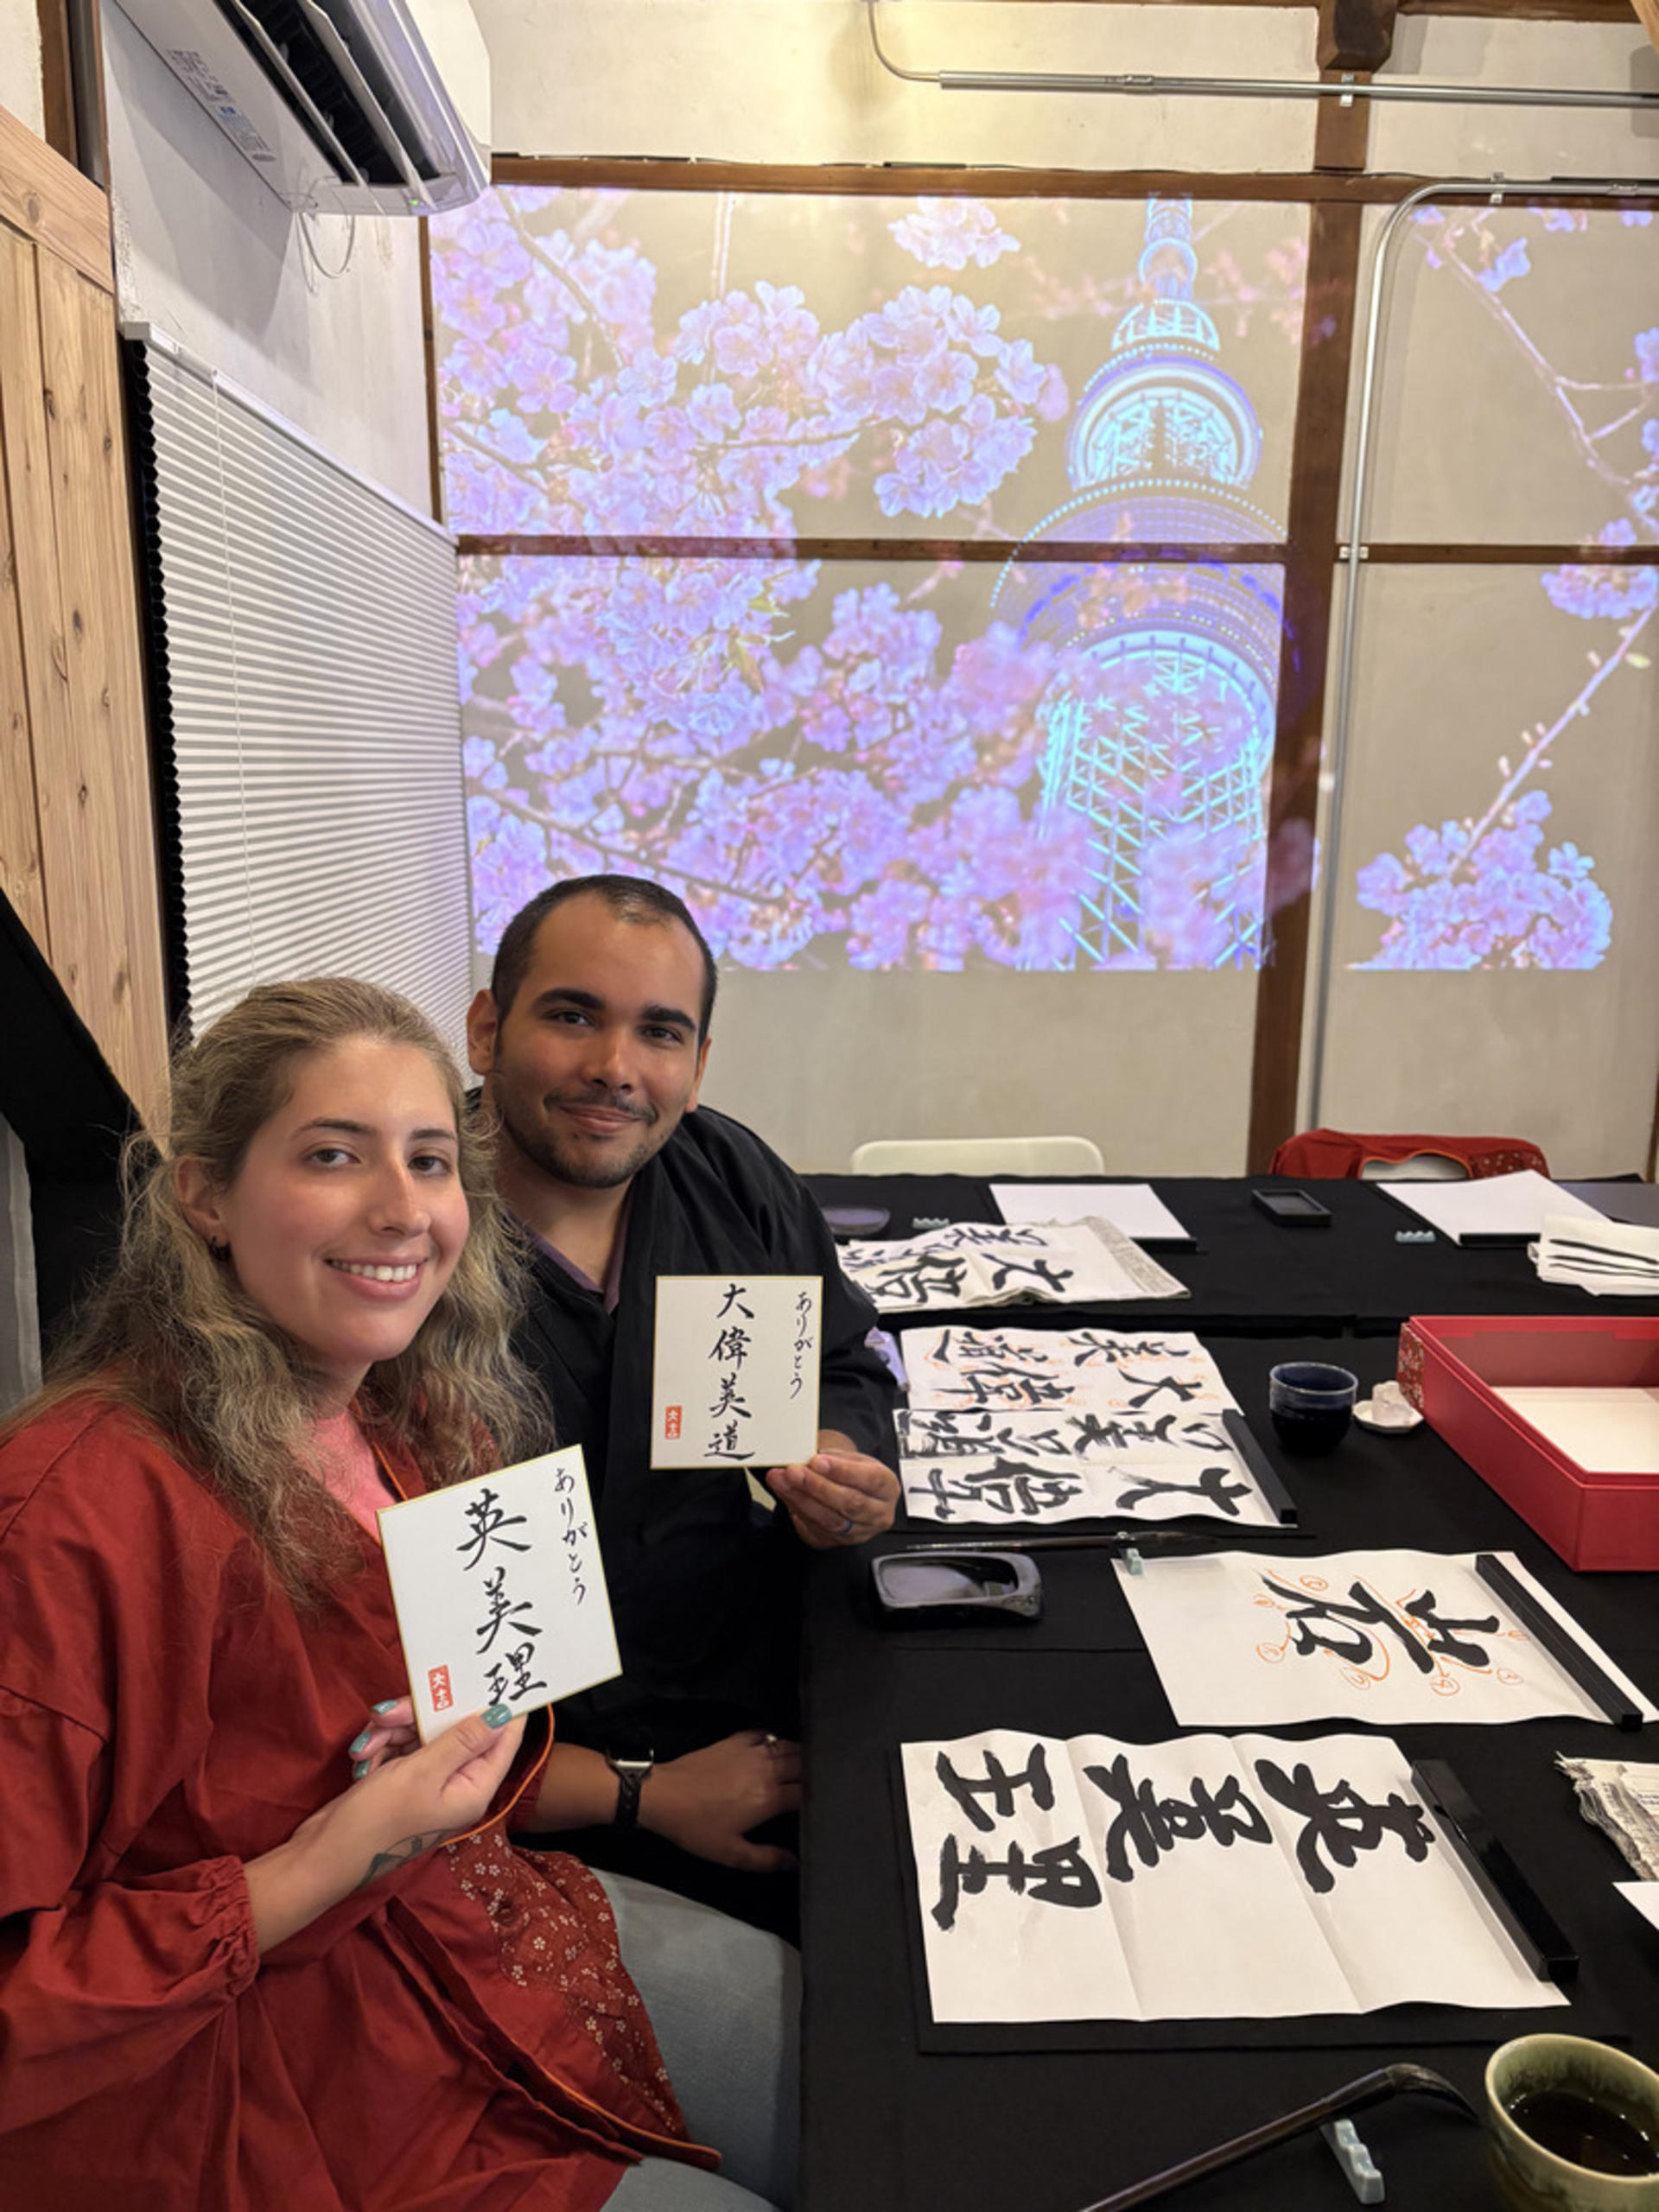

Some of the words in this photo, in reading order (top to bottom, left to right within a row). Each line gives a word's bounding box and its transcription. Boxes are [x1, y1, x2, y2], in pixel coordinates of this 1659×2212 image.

[790, 1291, 814, 1400] ありがとう
[555, 1467, 588, 1605] ありがとう
[1260, 1578, 1500, 1675] 岩
